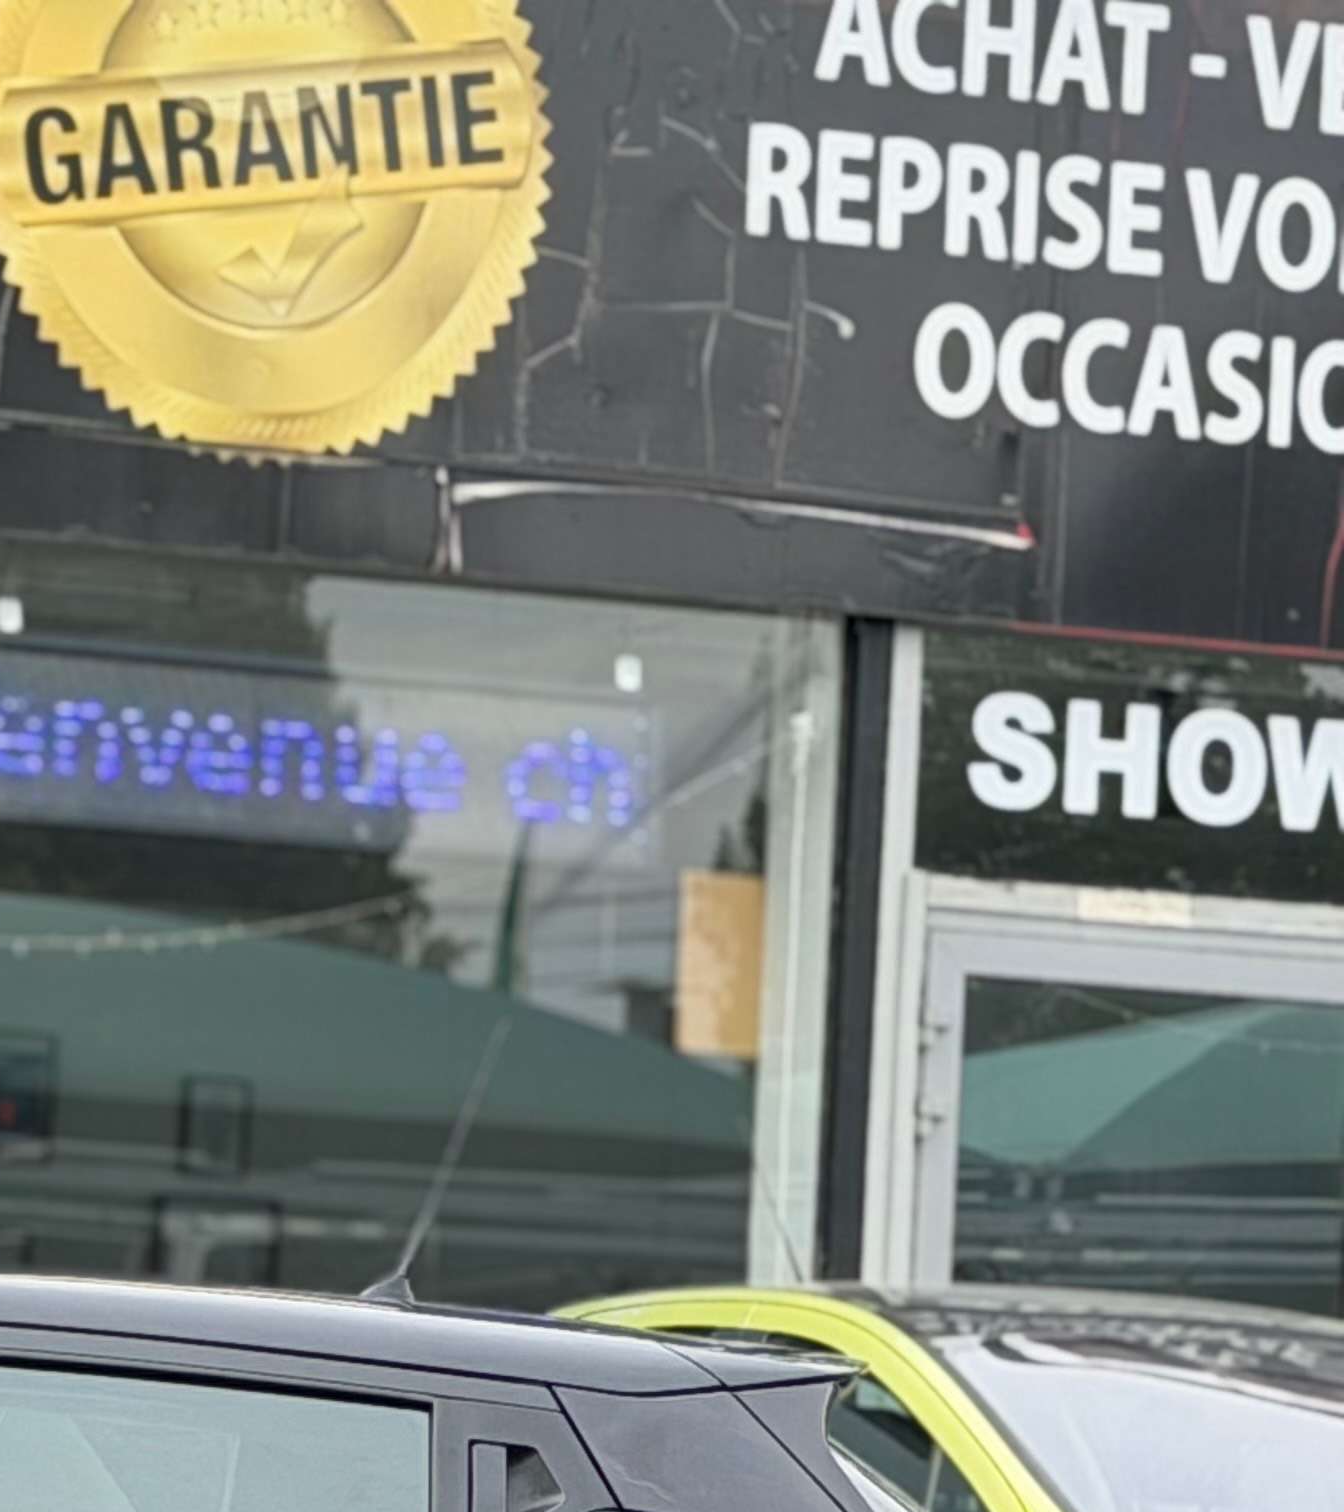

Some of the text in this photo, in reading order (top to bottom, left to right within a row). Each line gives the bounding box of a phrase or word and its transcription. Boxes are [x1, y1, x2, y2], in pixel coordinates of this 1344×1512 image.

[815, 0, 1171, 115] ACHAT
[24, 69, 505, 205] GARANTIE
[745, 121, 1344, 293] REPRISE VO
[967, 690, 1344, 832] SHOW
